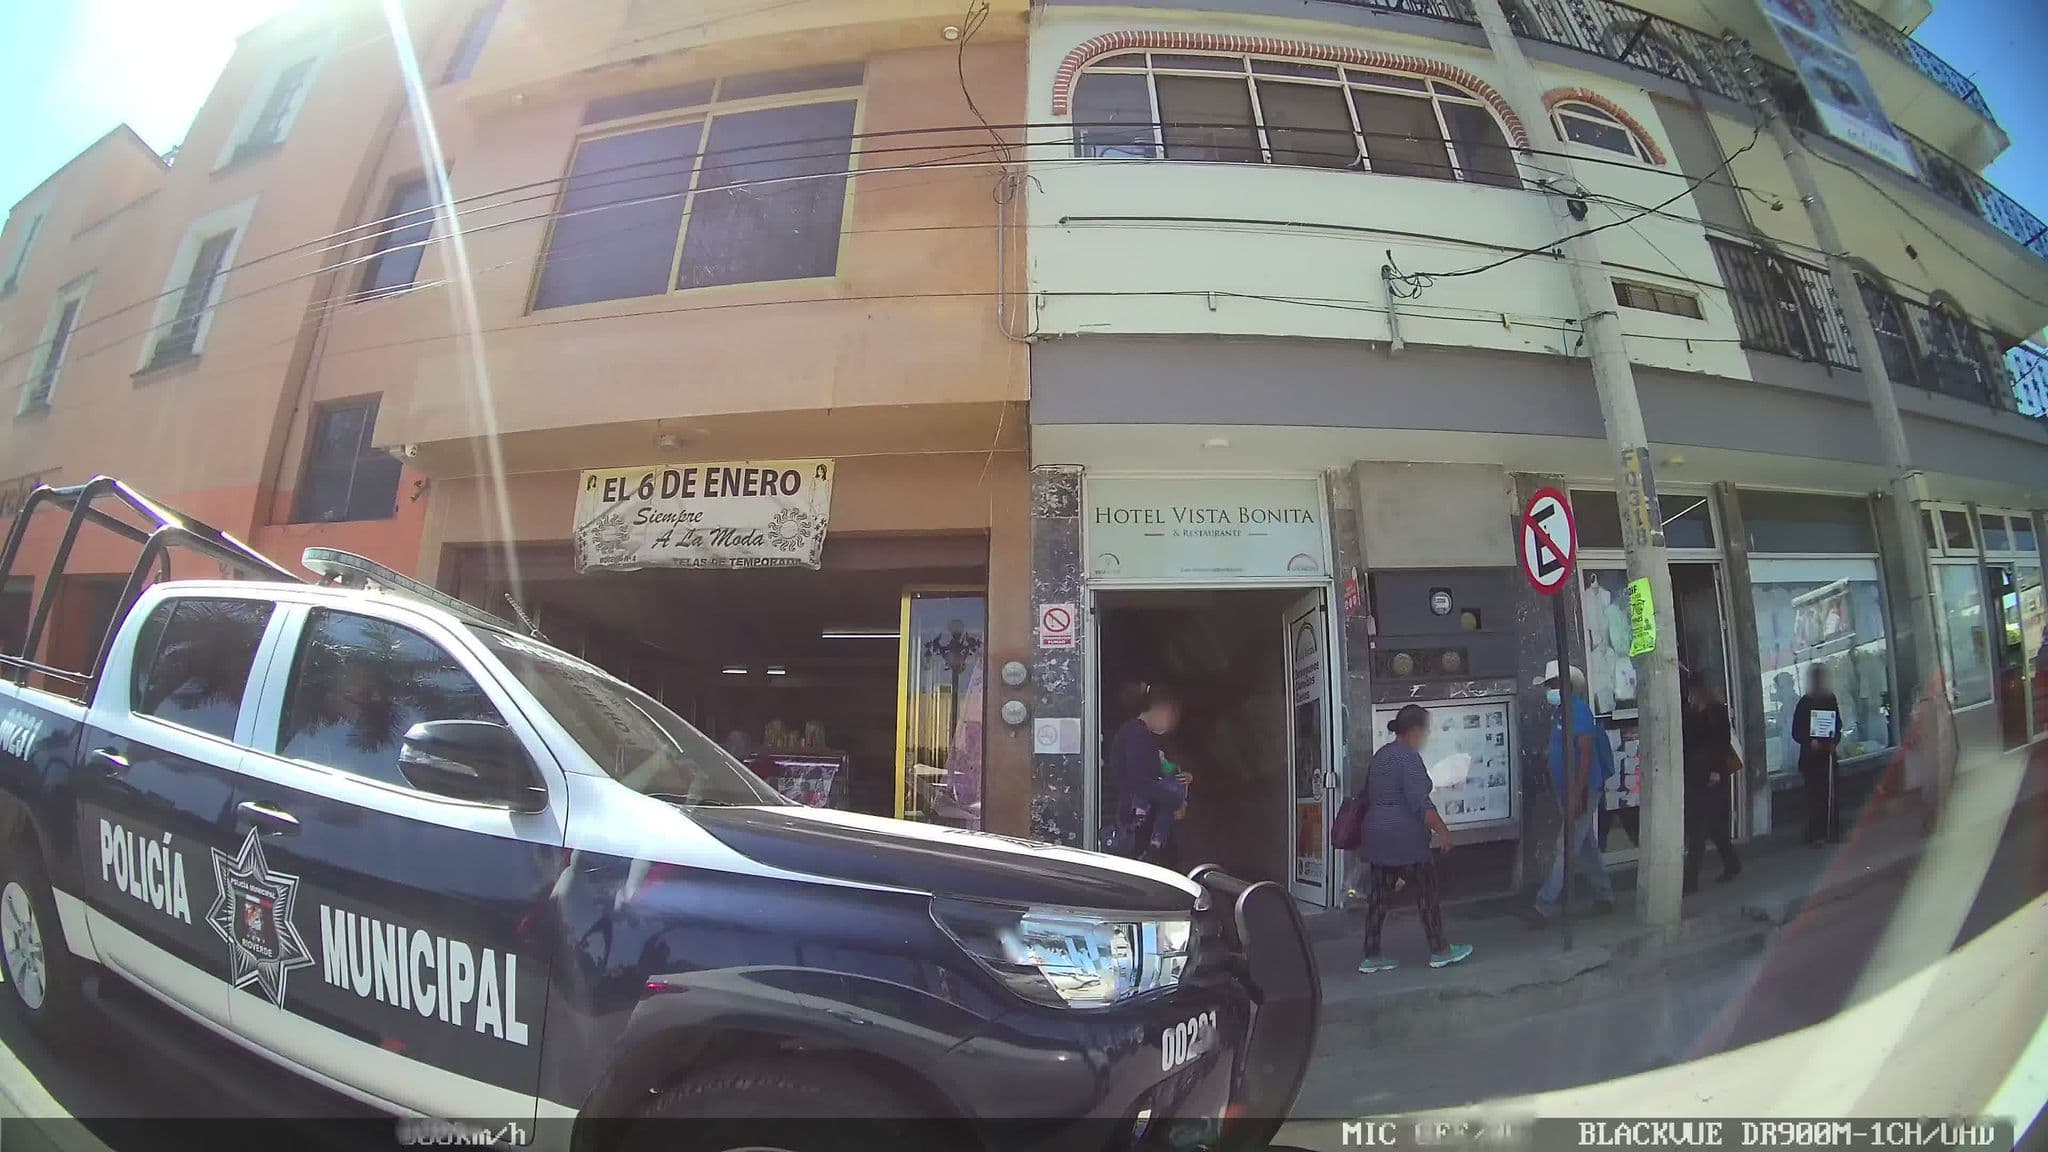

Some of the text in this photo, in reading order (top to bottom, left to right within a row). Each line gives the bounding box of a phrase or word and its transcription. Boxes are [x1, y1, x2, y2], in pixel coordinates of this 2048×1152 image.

[603, 467, 801, 502] EL 6 DE ENERO
[633, 507, 703, 528] Siempre
[1096, 507, 1314, 524] HOTEL VISTA BONITA
[651, 527, 765, 549] A La Moda
[99, 818, 192, 925] POLICÍA
[319, 904, 529, 1047] MUNICIPAL
